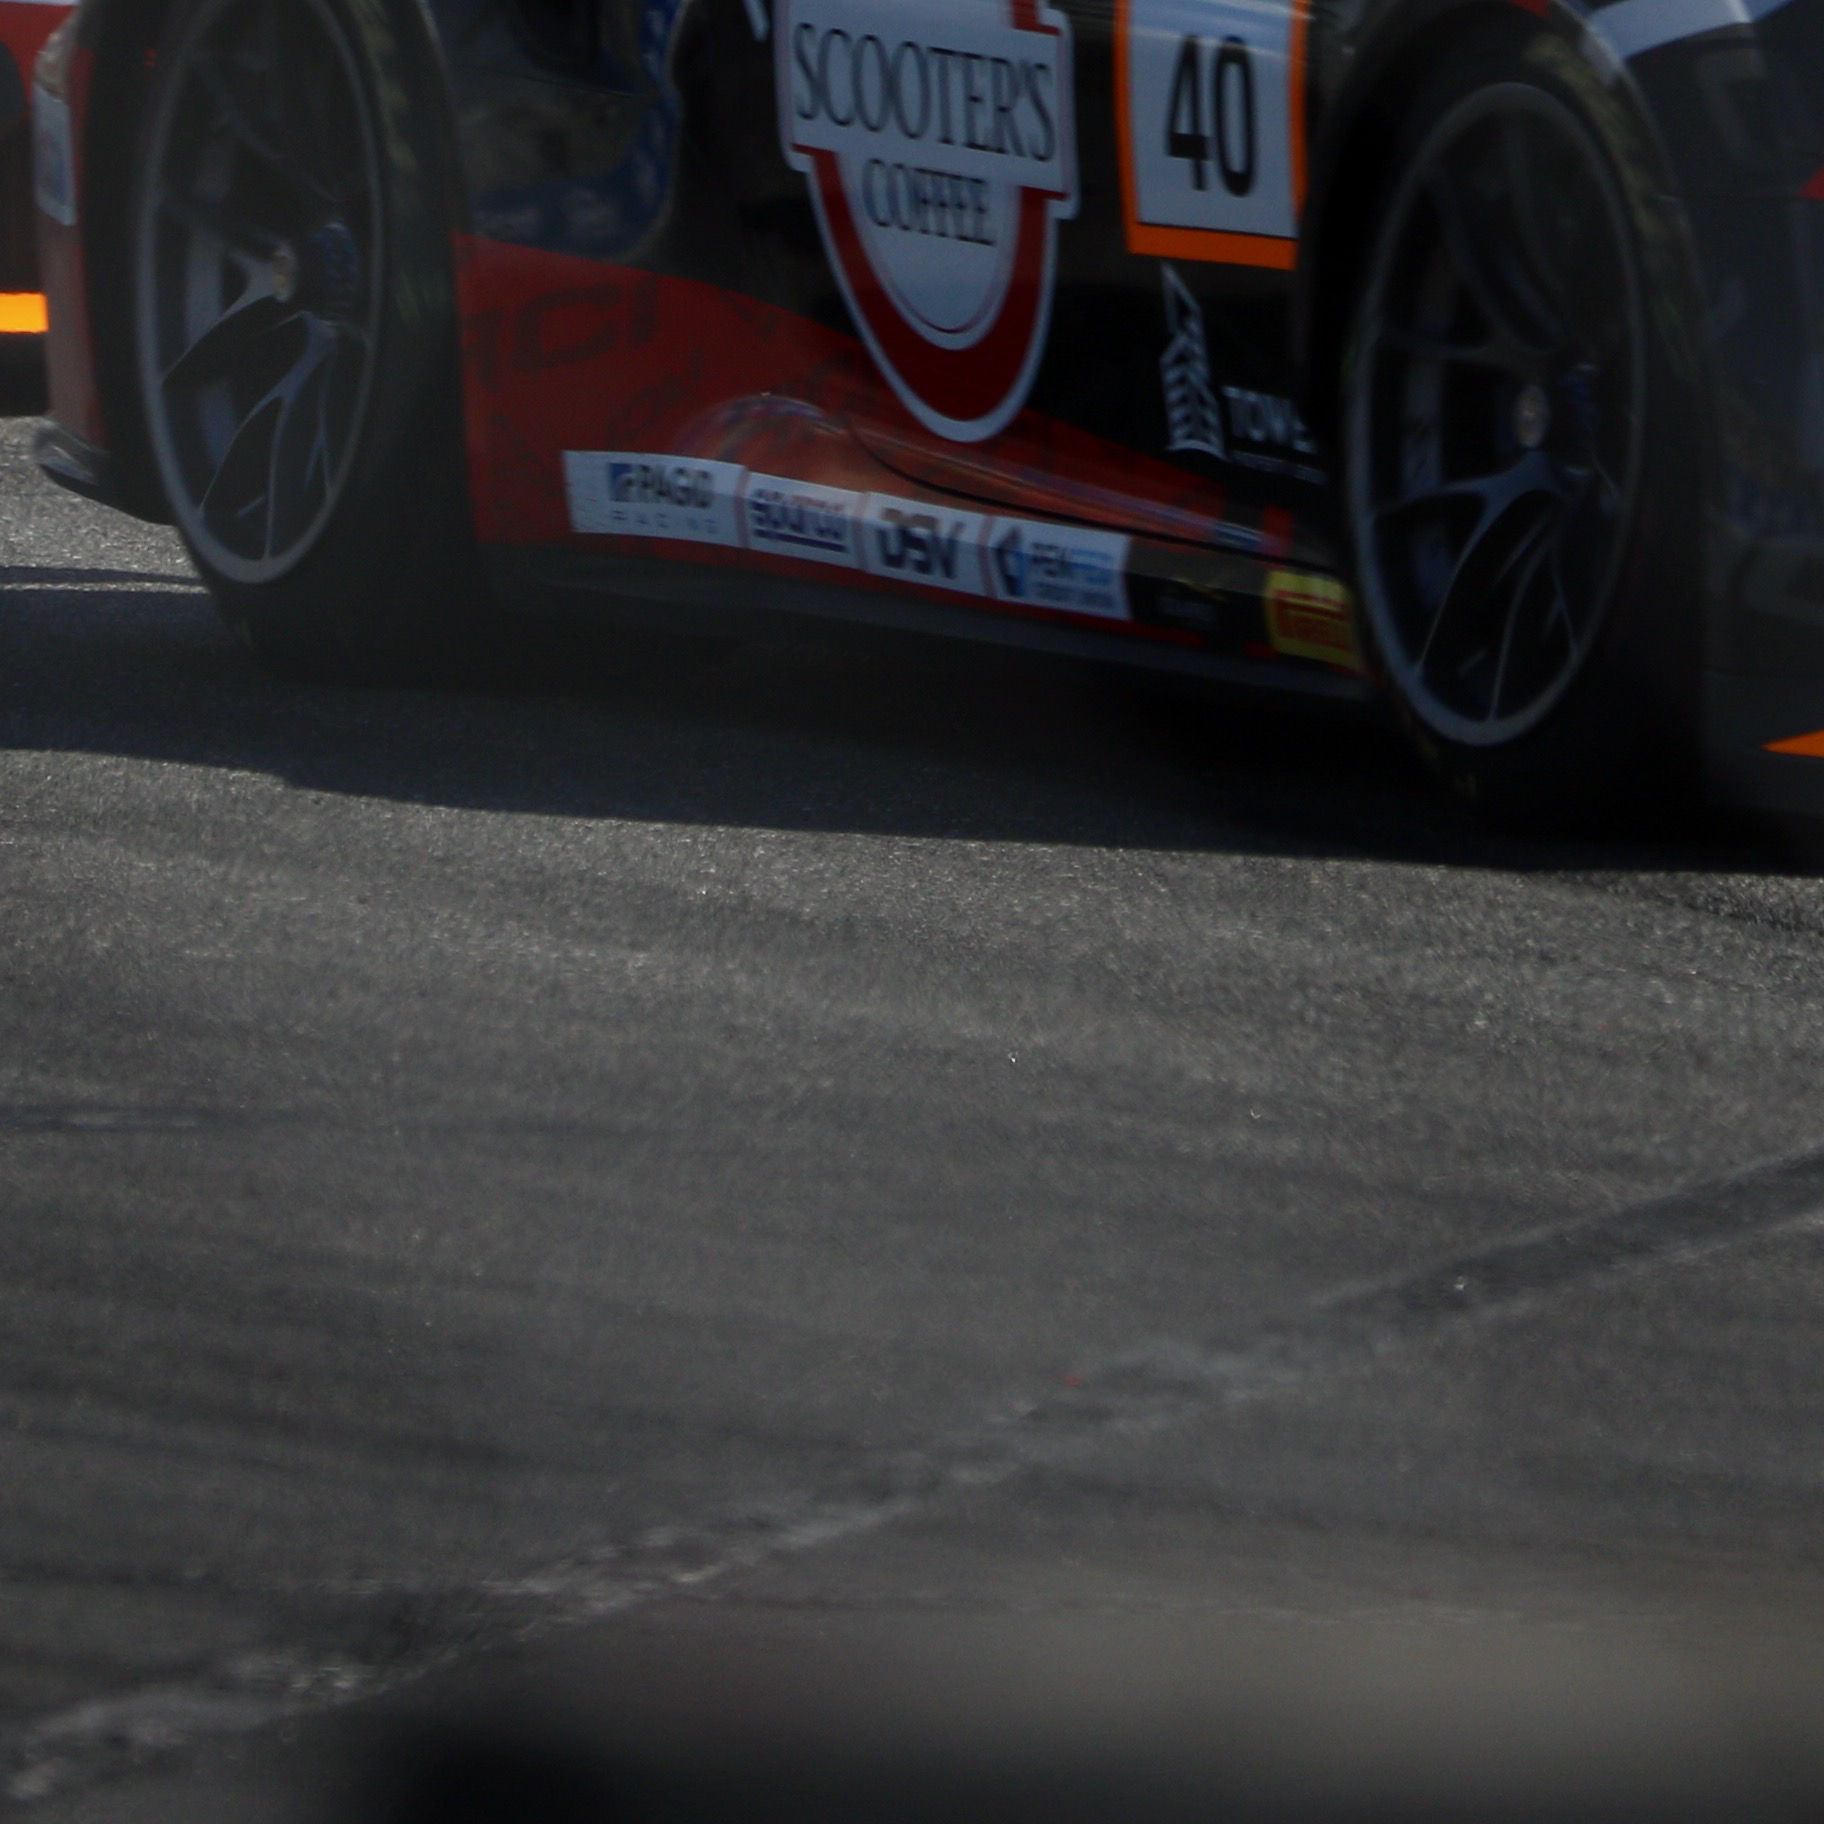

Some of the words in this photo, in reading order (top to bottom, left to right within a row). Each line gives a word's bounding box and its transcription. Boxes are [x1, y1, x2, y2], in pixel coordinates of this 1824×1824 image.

[793, 19, 1056, 162] SCOOTER'S
[1165, 33, 1259, 198] 40
[864, 155, 997, 249] COFFEE
